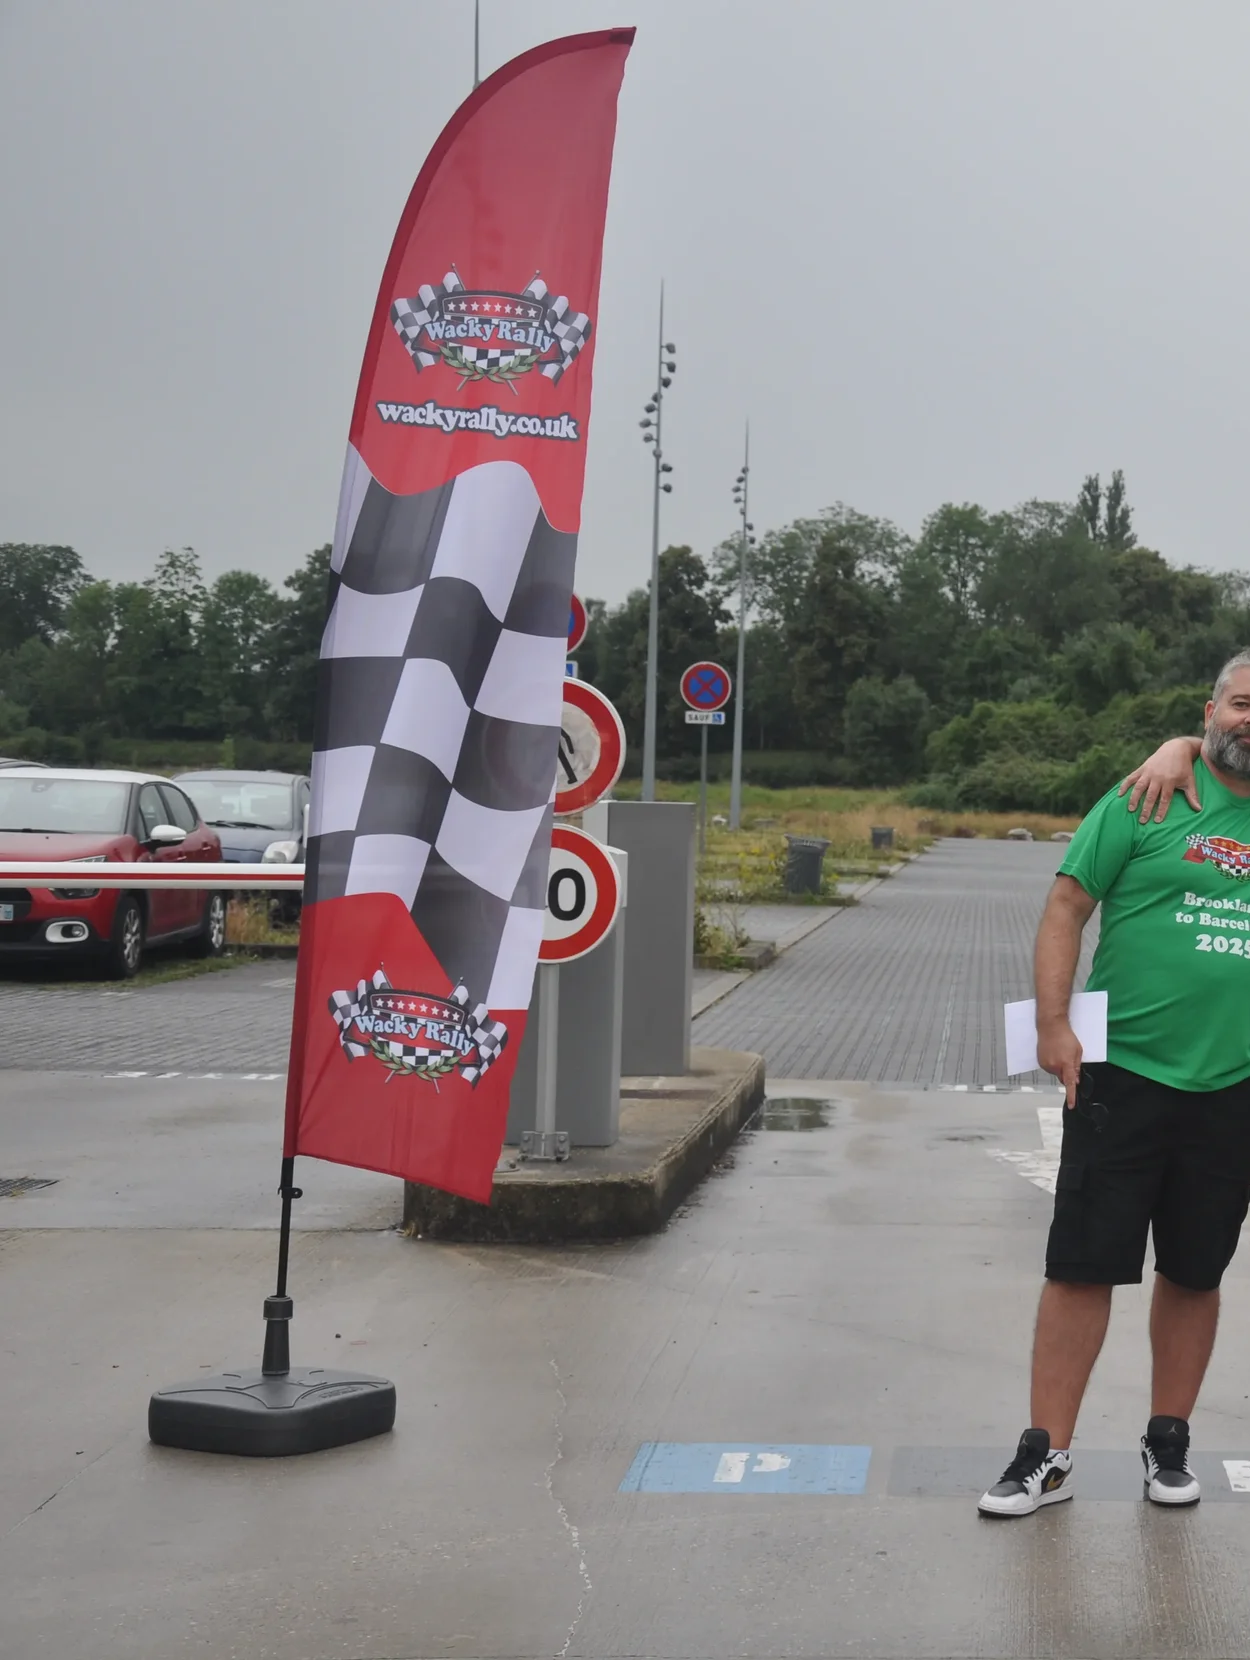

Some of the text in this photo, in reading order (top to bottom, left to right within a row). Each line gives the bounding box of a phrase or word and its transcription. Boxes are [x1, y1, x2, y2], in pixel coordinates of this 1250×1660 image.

[424, 319, 555, 352] Wacky Rally
[376, 402, 578, 439] wackyrally.co.uk
[1201, 845, 1236, 864] Wacky
[1175, 912, 1194, 923] to
[355, 1015, 475, 1055] Wacky Rally
